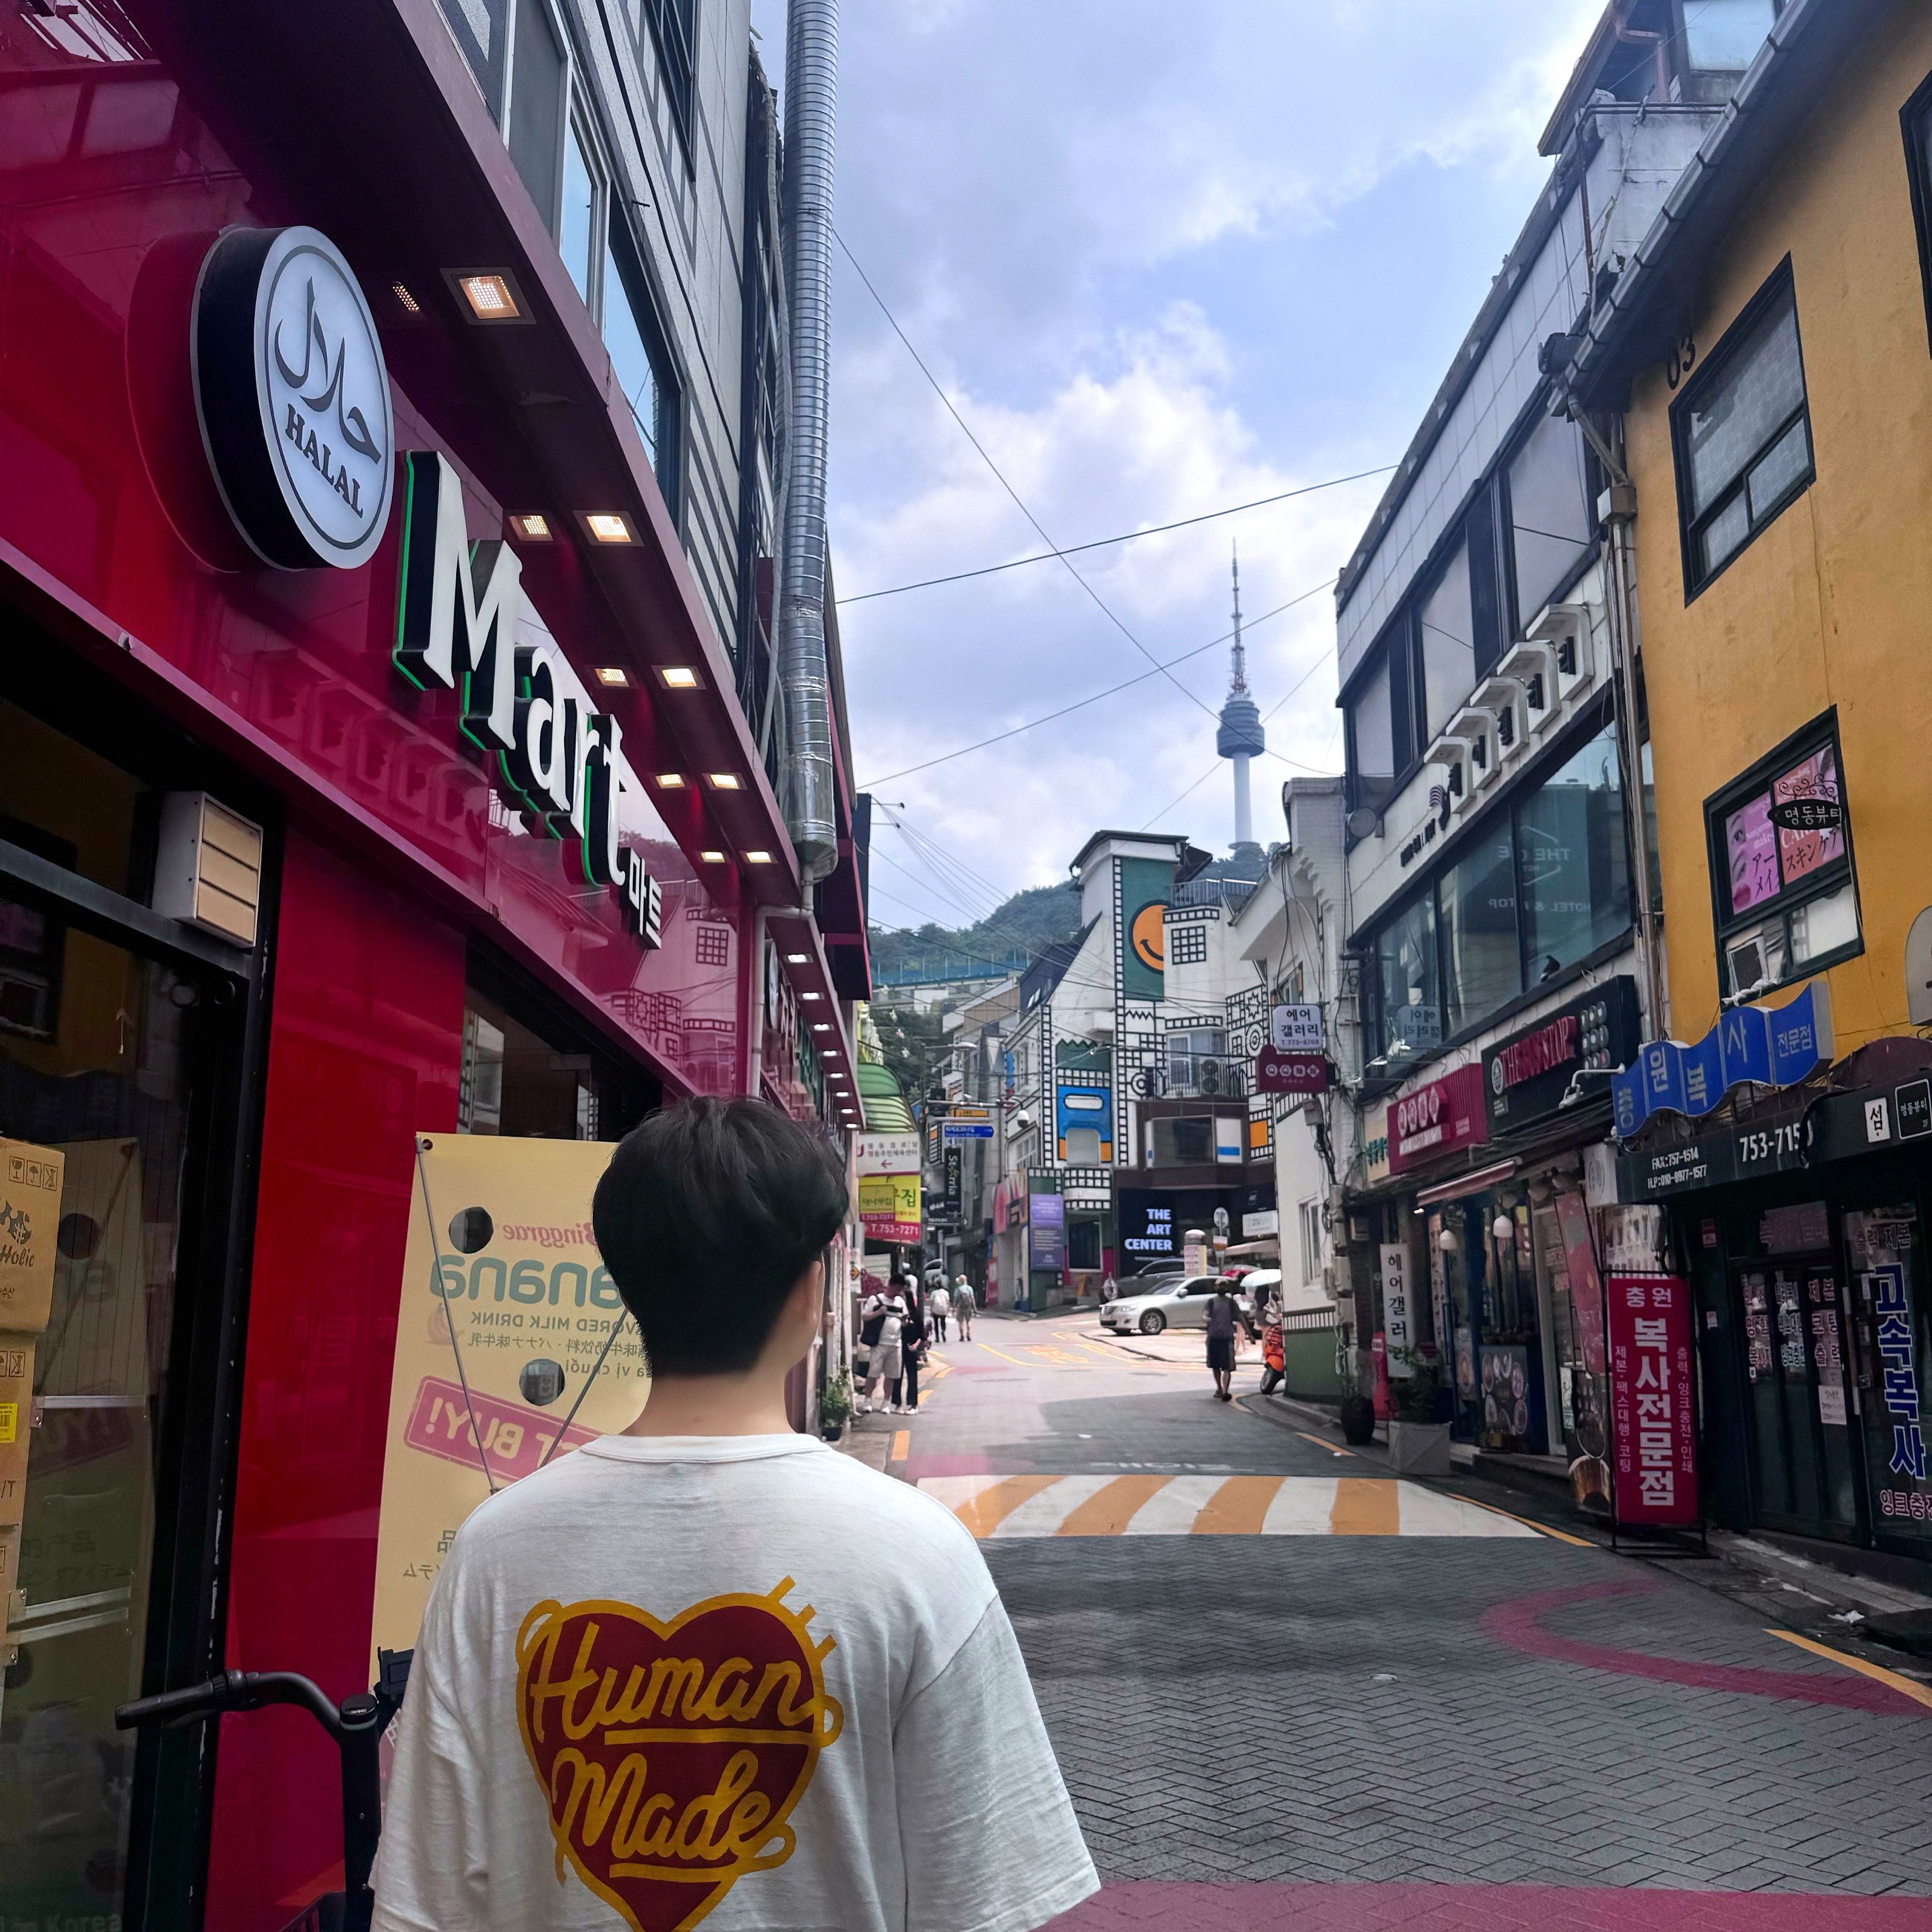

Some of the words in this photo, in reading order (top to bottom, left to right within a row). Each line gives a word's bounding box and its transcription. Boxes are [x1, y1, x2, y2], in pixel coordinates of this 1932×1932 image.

[274, 275, 382, 465] حلال
[286, 403, 363, 518] HALAL
[416, 451, 626, 887] Mart
[1785, 806, 1842, 825] 명동뷰티
[629, 847, 662, 949] 마트
[1281, 1024, 1318, 1037] 갤러리
[1286, 1008, 1311, 1022] 헤어
[1776, 1023, 1813, 1059] 전문점
[1900, 1097, 1928, 1117] 명동뷰티
[1146, 1209, 1171, 1220] THE
[1146, 1224, 1172, 1235] ART
[1124, 1238, 1173, 1250] CENTER
[1626, 1286, 1673, 1308] 충원
[1873, 1261, 1926, 1481] 고속복사
[1634, 1317, 1675, 1506] 복사전문점
[524, 1609, 823, 1743] Human
[551, 1747, 781, 1862] Made
